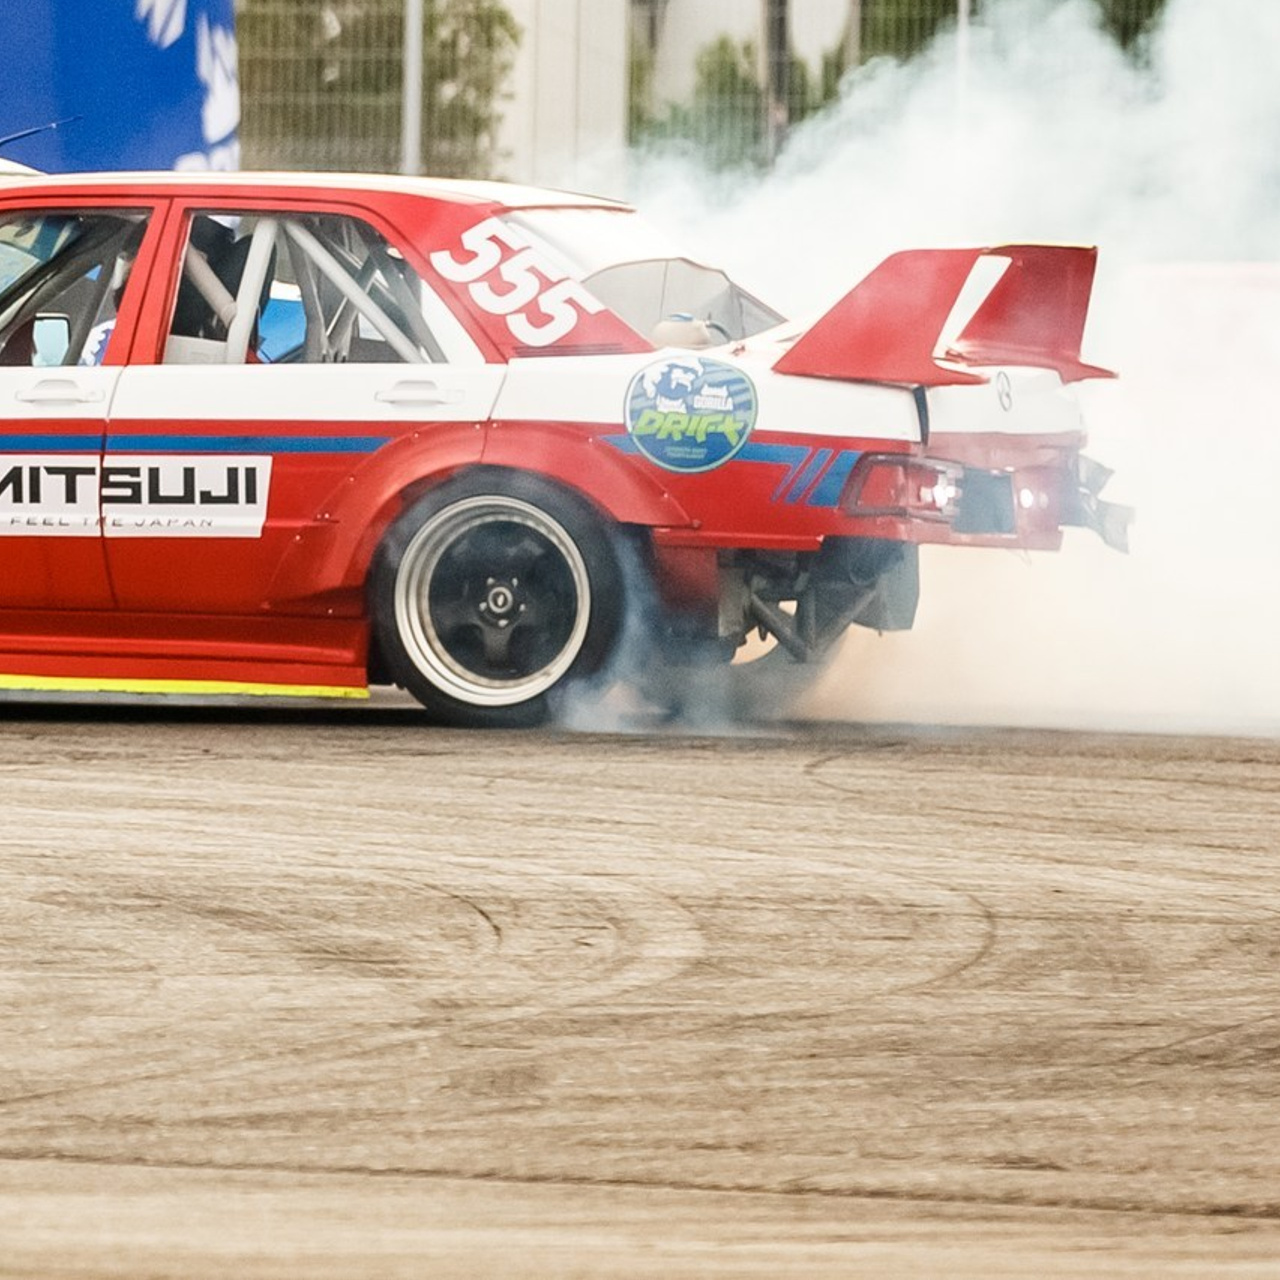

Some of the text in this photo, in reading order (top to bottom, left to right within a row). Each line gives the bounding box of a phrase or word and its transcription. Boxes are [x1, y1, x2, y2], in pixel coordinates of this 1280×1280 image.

[429, 216, 607, 347] 555
[632, 409, 744, 447] DRIFT
[10, 516, 70, 527] FEEL
[134, 517, 215, 528] JAPAN
